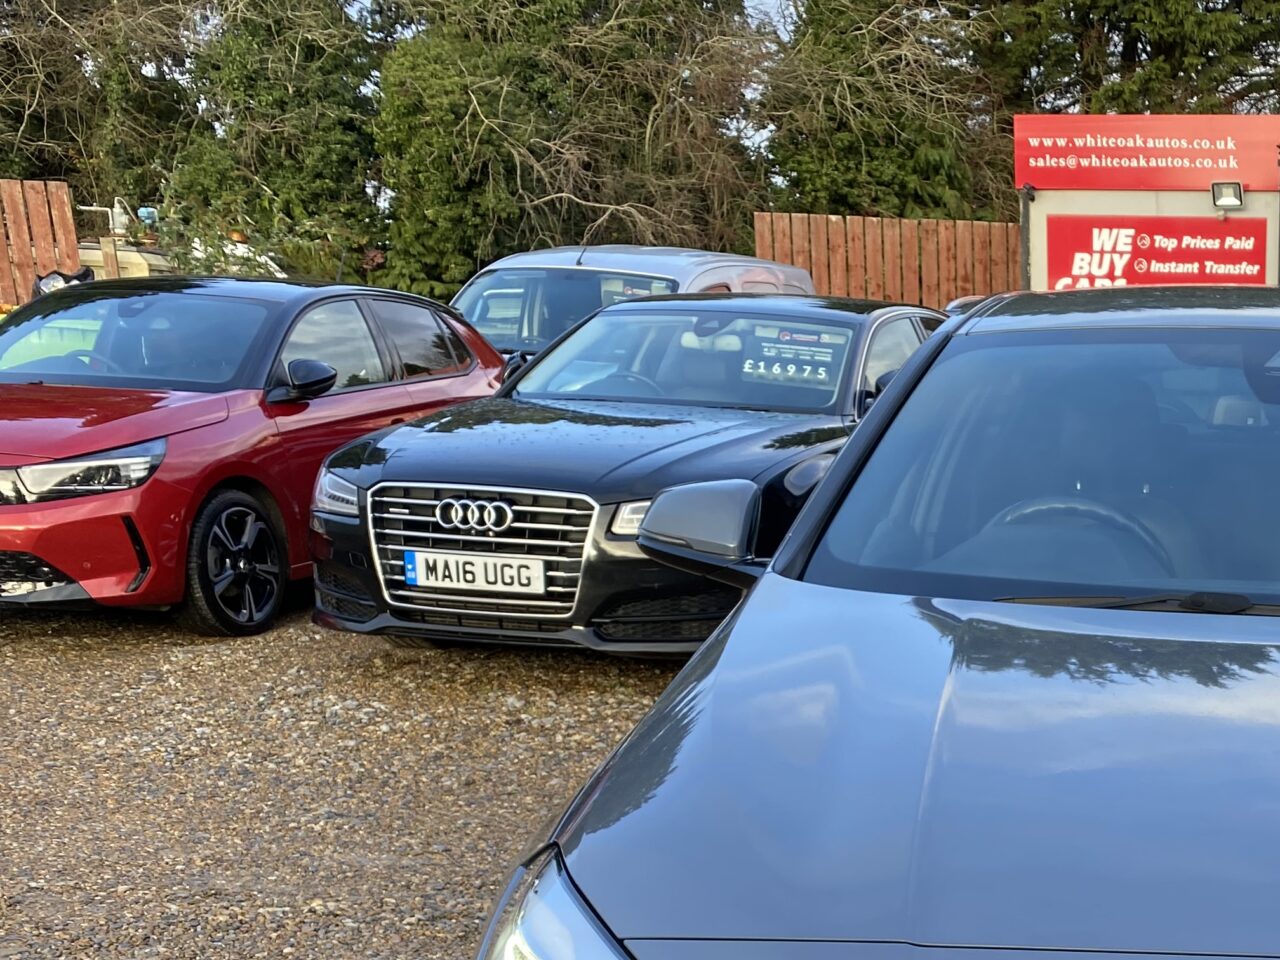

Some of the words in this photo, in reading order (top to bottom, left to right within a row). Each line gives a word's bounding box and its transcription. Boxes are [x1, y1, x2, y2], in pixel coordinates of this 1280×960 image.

[1028, 134, 1237, 150] www.whiteoakautos.co.uk
[1028, 154, 1239, 169] sales@whiteoakautos.co.uk
[1092, 228, 1135, 252] WE
[1153, 235, 1177, 251] Top
[1181, 236, 1220, 249] Prices
[1224, 236, 1255, 249] Paid
[1071, 252, 1131, 276] BUY
[1150, 260, 1199, 273] Instant
[1204, 261, 1260, 275] Transfer
[743, 359, 826, 379] £16975
[424, 558, 476, 584] MA16
[483, 564, 531, 587] UGG
